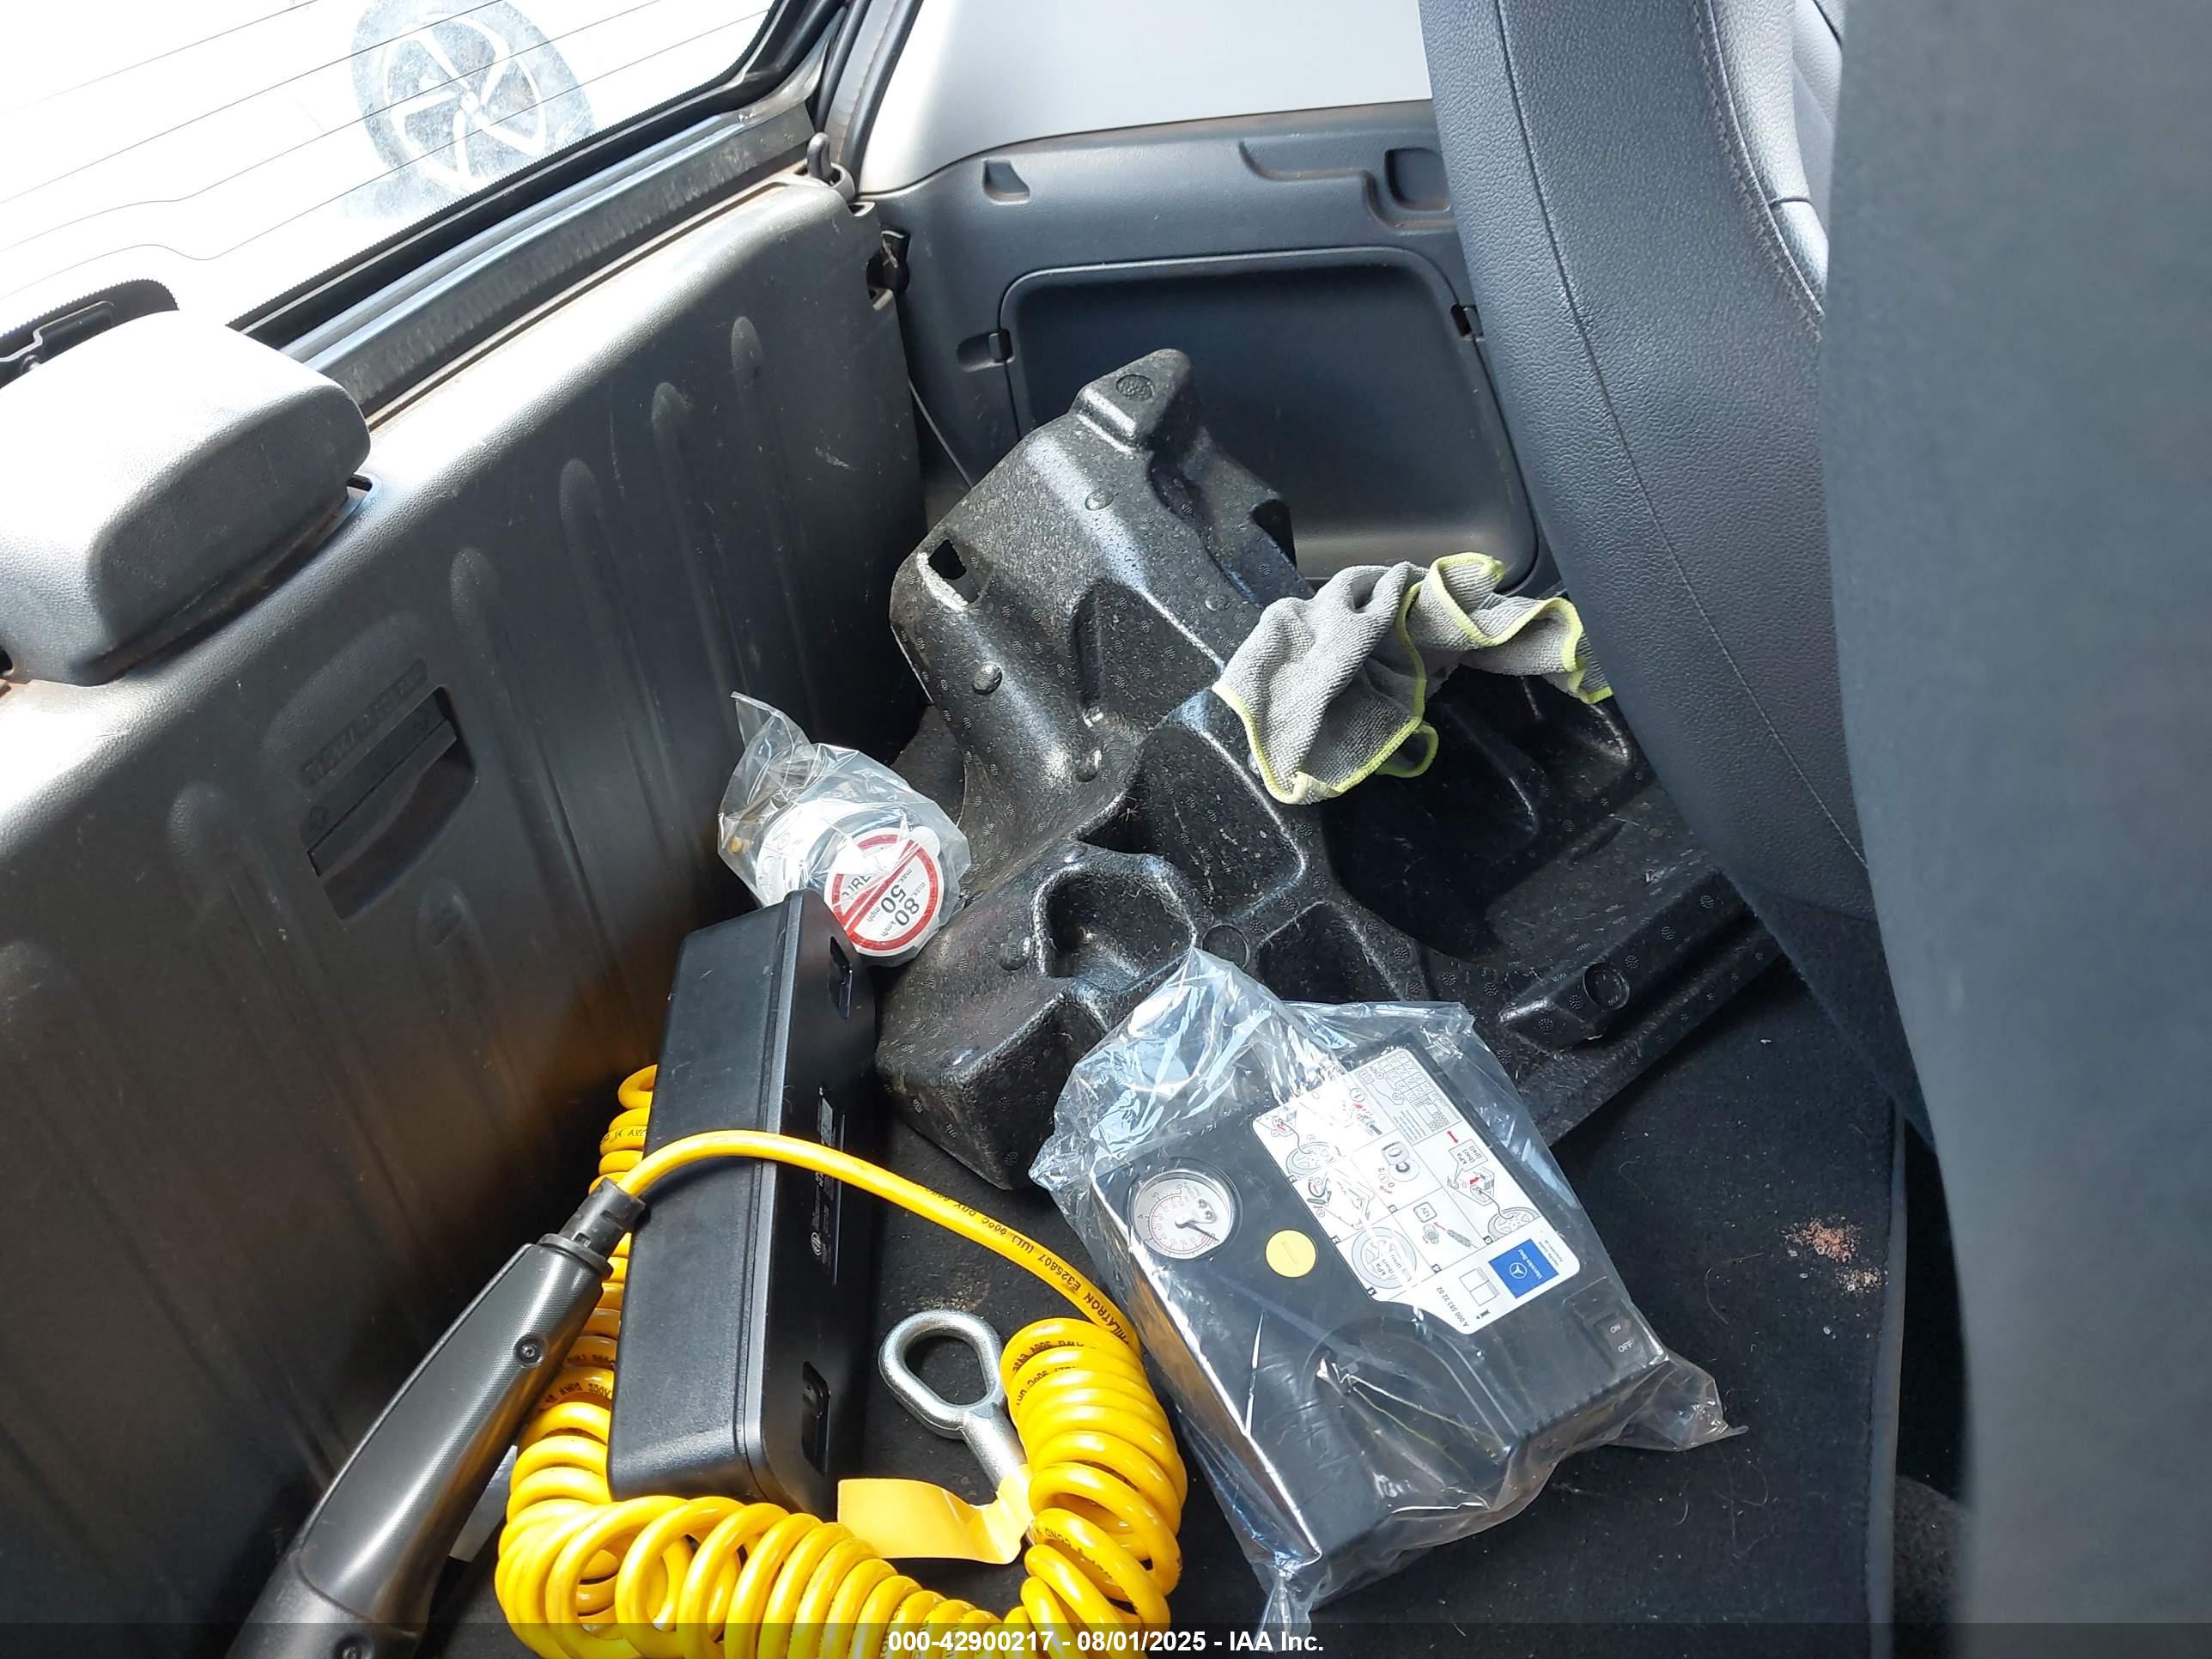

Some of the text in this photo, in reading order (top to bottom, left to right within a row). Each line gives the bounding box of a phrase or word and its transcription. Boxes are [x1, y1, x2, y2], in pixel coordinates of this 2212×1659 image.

[866, 867, 913, 922] max. 50 mph
[880, 881, 926, 937] max. 80 km/h
[1012, 1235, 1034, 1255] (UL)
[1037, 1254, 1082, 1291] E325807
[1083, 1291, 1130, 1345] HILATRON
[1455, 1311, 1466, 1322] 000
[1610, 1323, 1621, 1334] ON
[1618, 1340, 1635, 1353] OFF
